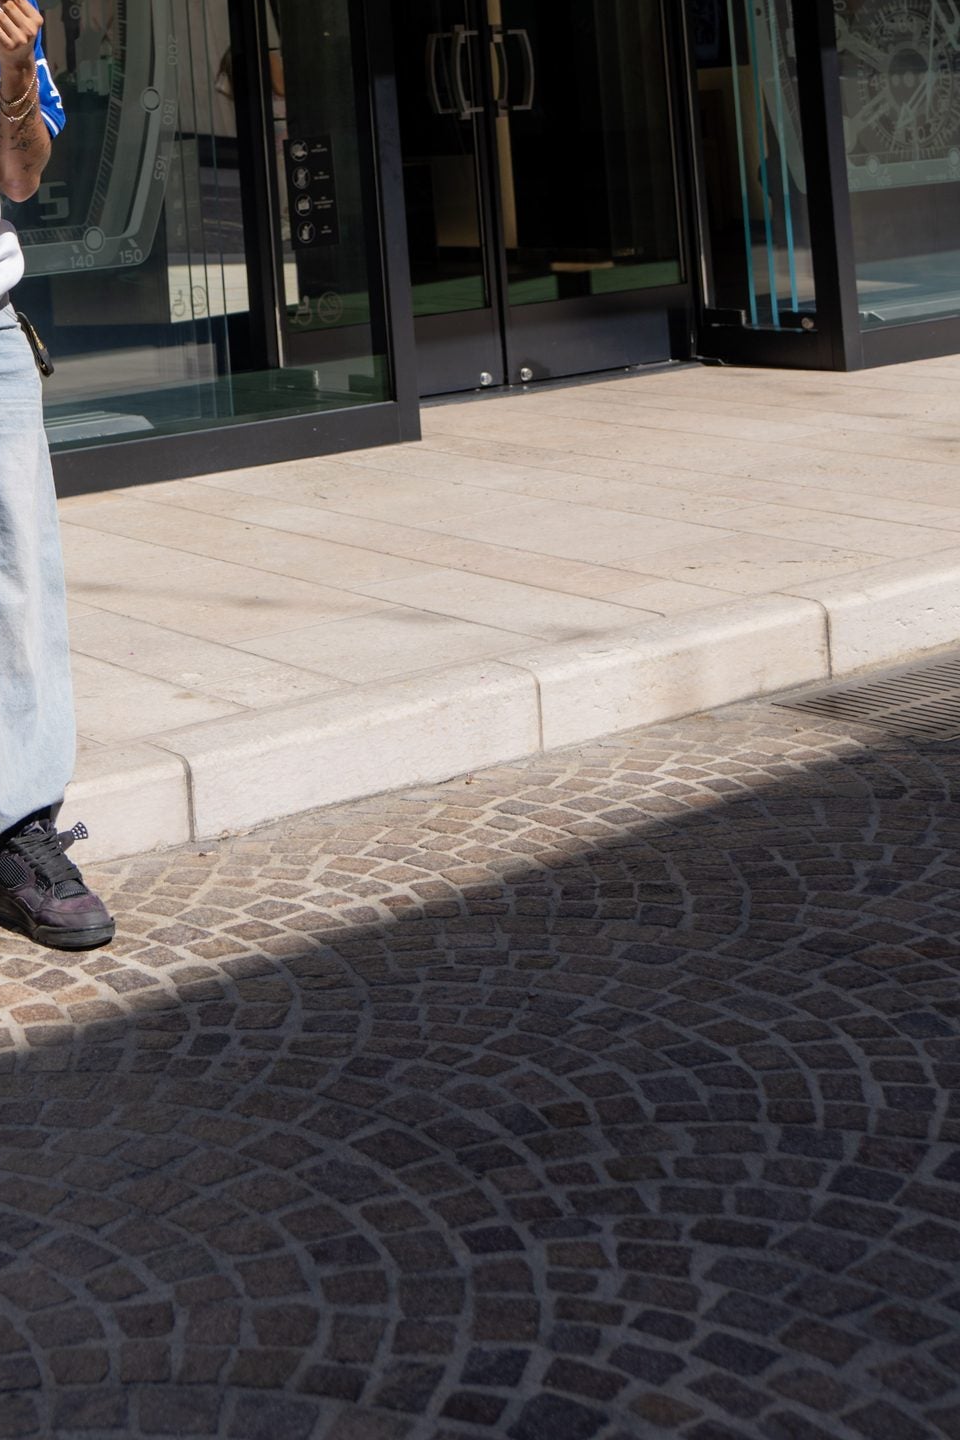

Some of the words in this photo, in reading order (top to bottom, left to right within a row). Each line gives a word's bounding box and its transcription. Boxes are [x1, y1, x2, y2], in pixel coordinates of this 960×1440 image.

[37, 180, 70, 221] 5
[69, 253, 95, 269] 140
[119, 248, 144, 265] 150
